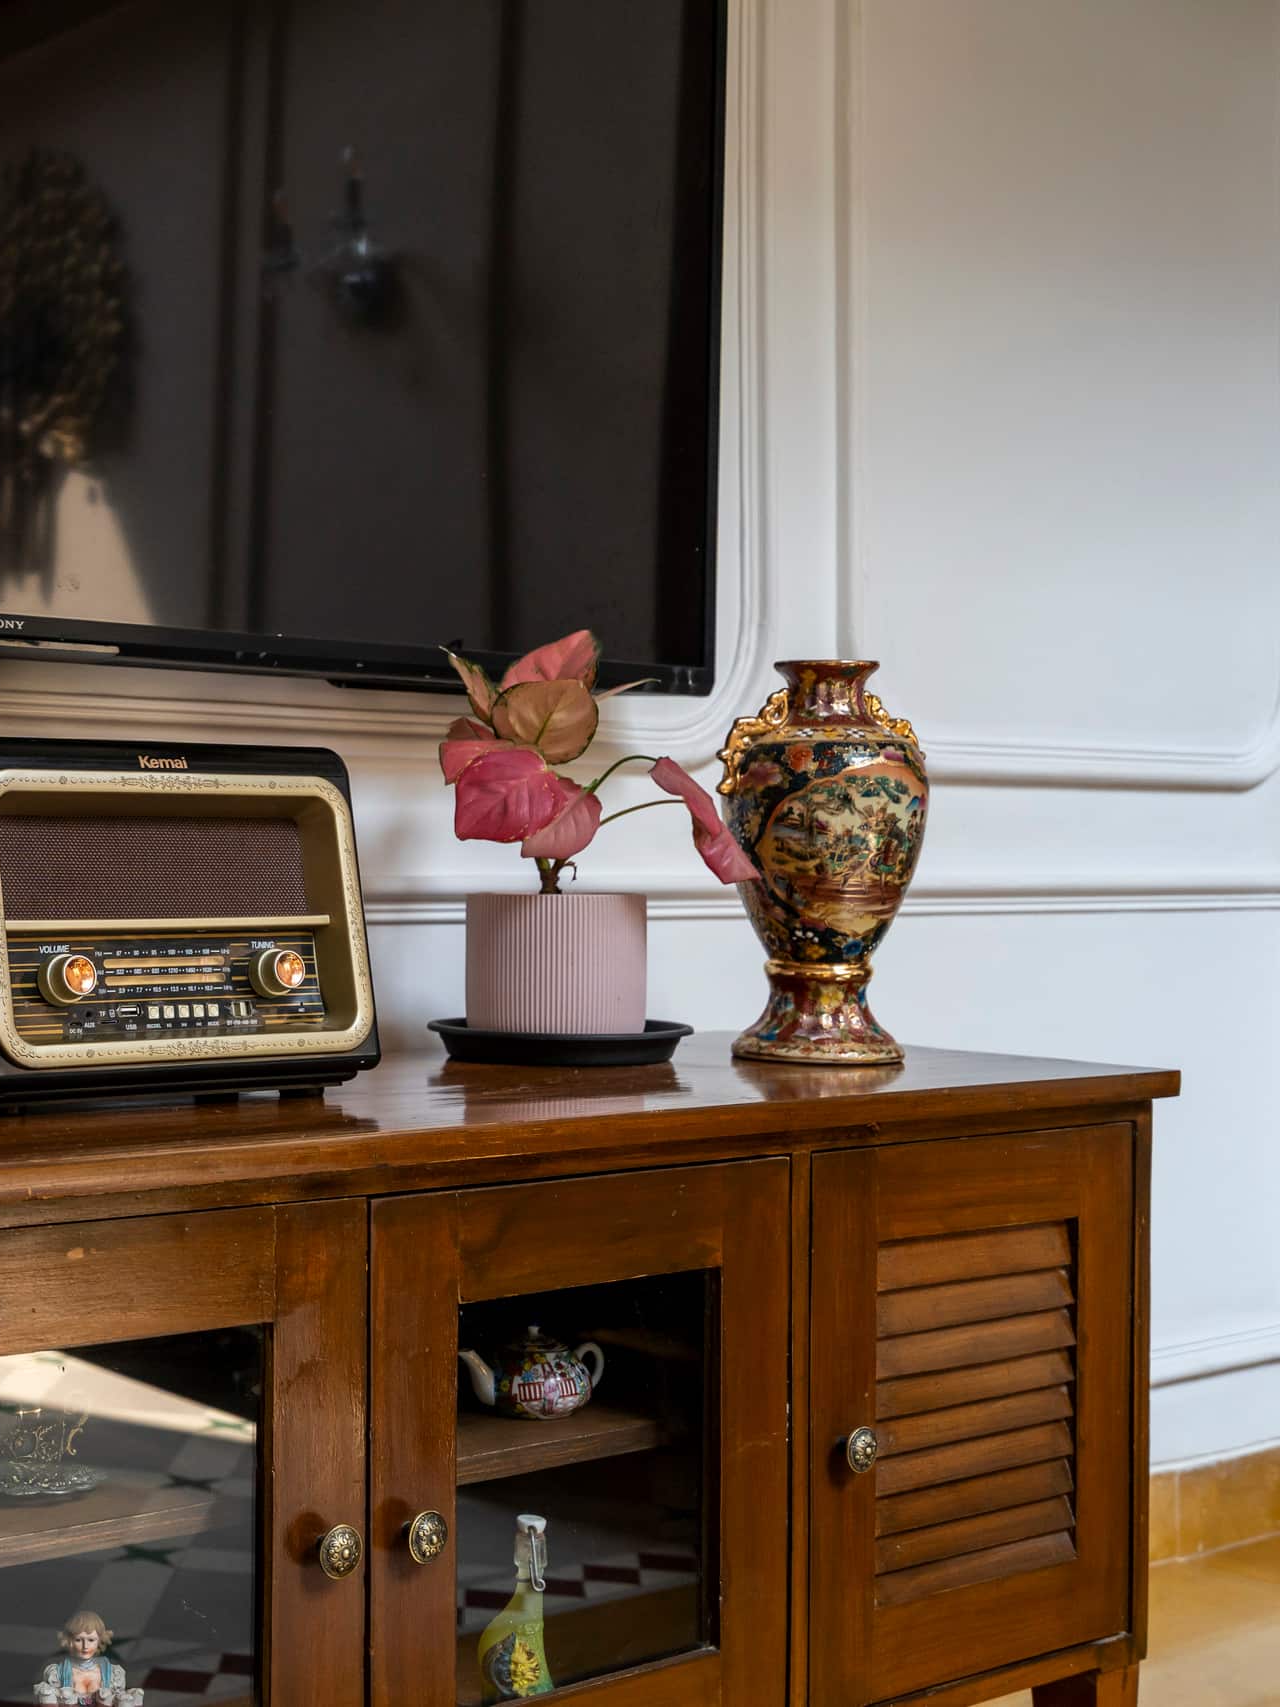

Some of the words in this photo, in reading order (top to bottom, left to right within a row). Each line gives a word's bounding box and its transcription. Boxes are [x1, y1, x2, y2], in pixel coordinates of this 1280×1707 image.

[137, 755, 188, 769] Kemai
[39, 944, 70, 954] VOLUME
[251, 940, 274, 949] TUNING
[125, 1023, 137, 1031] USB
